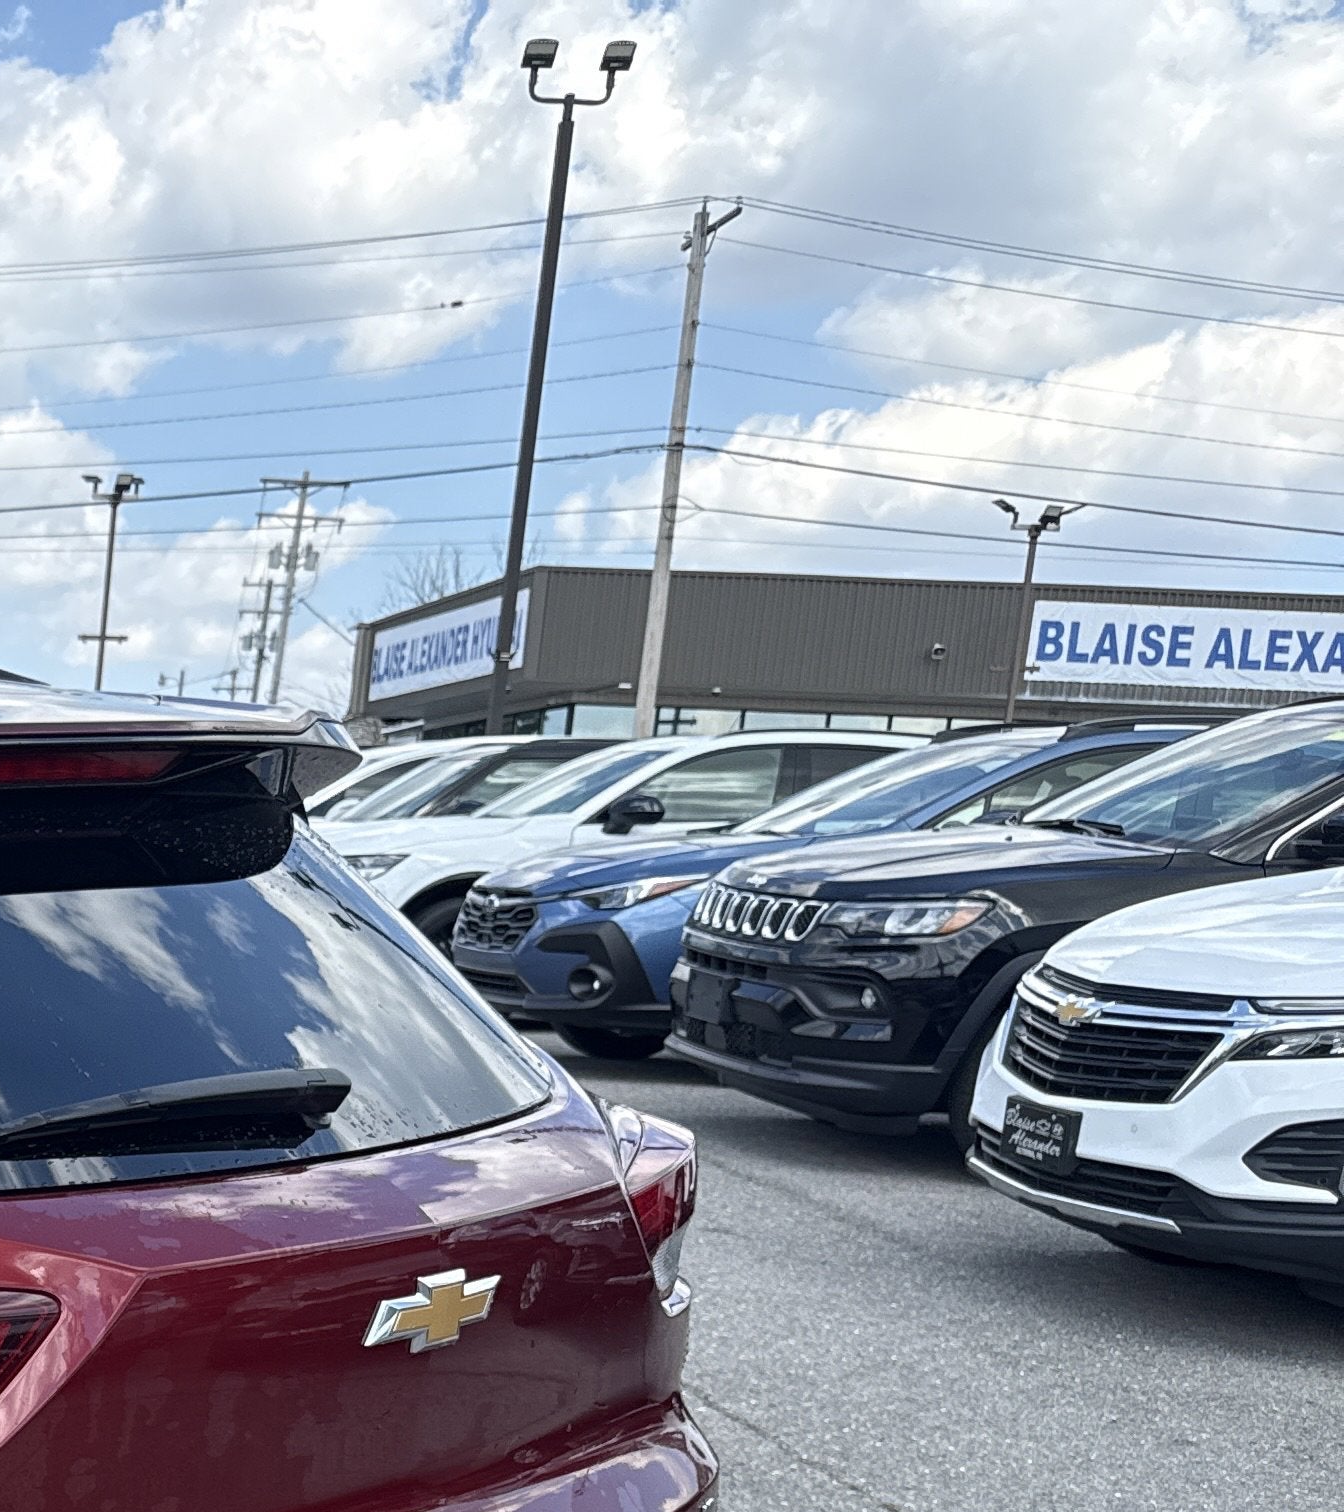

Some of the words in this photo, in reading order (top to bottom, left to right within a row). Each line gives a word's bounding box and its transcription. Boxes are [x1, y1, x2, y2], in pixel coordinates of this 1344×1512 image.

[371, 640, 408, 684] BLAISE
[407, 624, 471, 676] ALEXANDER
[1035, 619, 1195, 668] BLAISE
